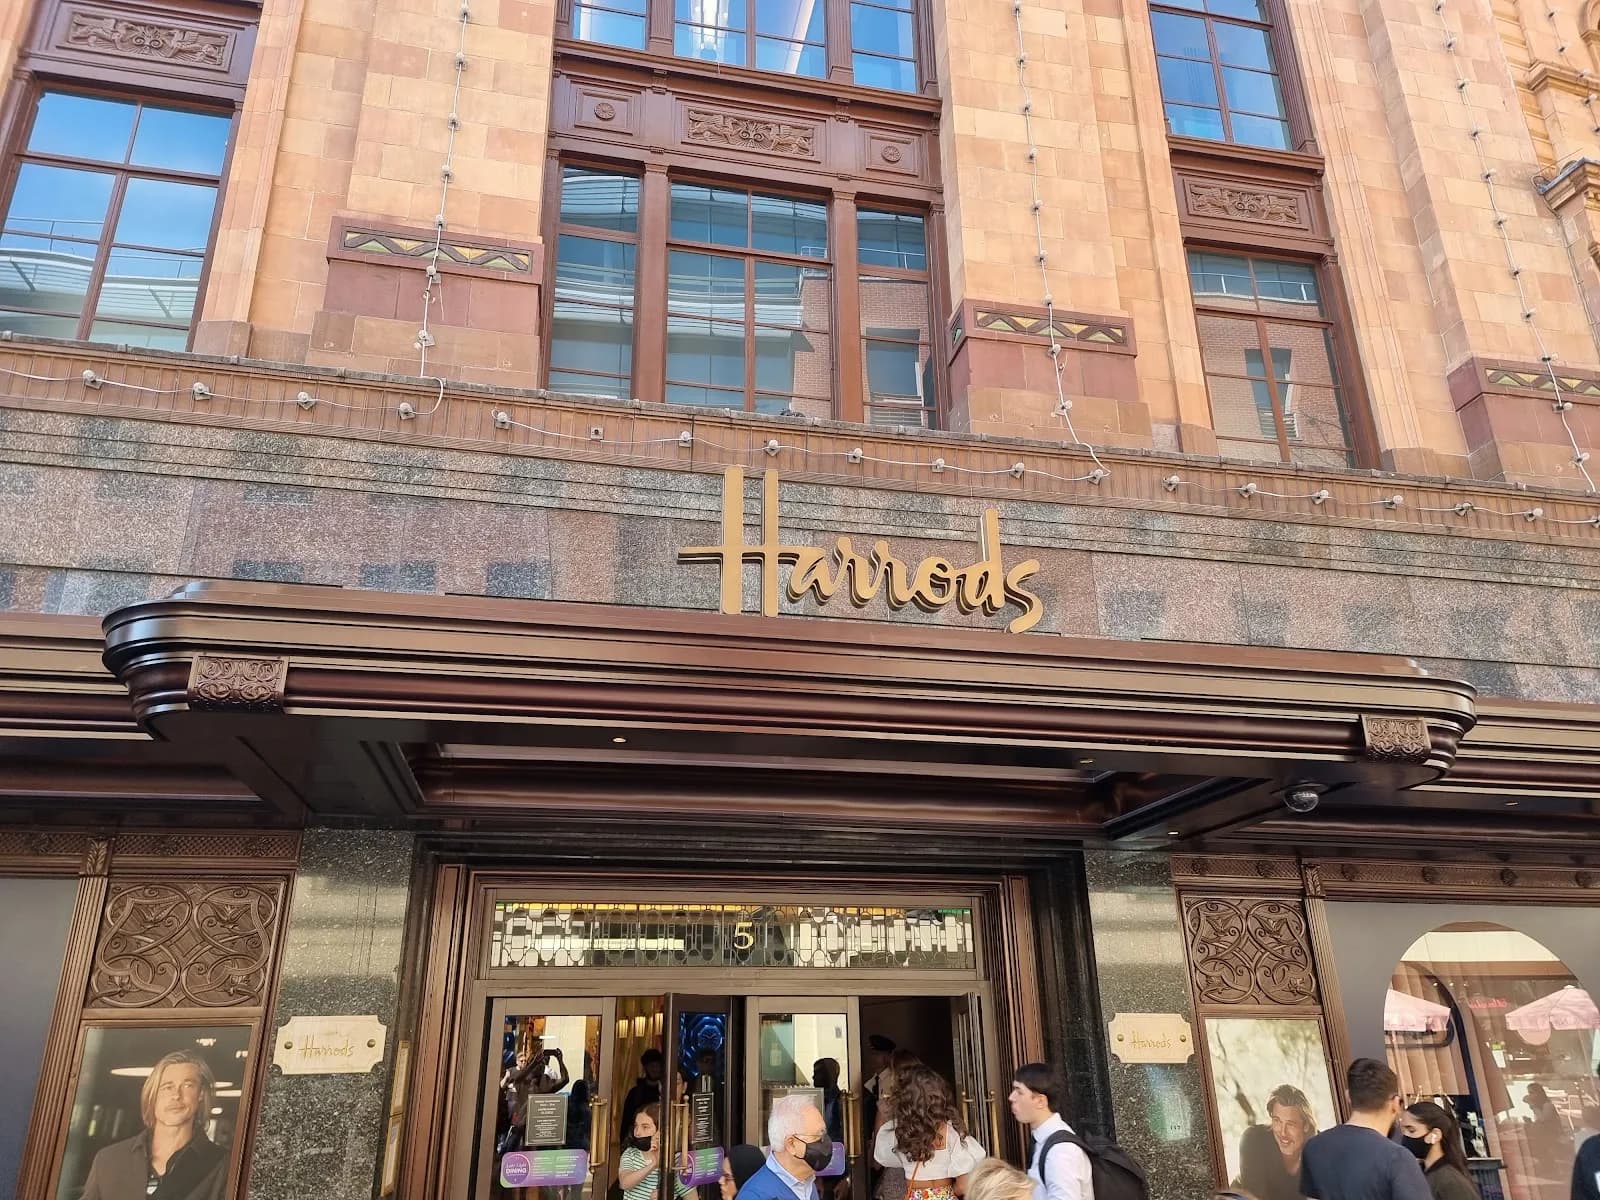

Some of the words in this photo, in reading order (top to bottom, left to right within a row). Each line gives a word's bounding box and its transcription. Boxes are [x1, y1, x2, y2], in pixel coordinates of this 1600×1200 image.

[678, 465, 1043, 634] Harrods
[734, 921, 754, 950] 5
[298, 1034, 355, 1058] Harrods
[1128, 1030, 1173, 1049] Harrods
